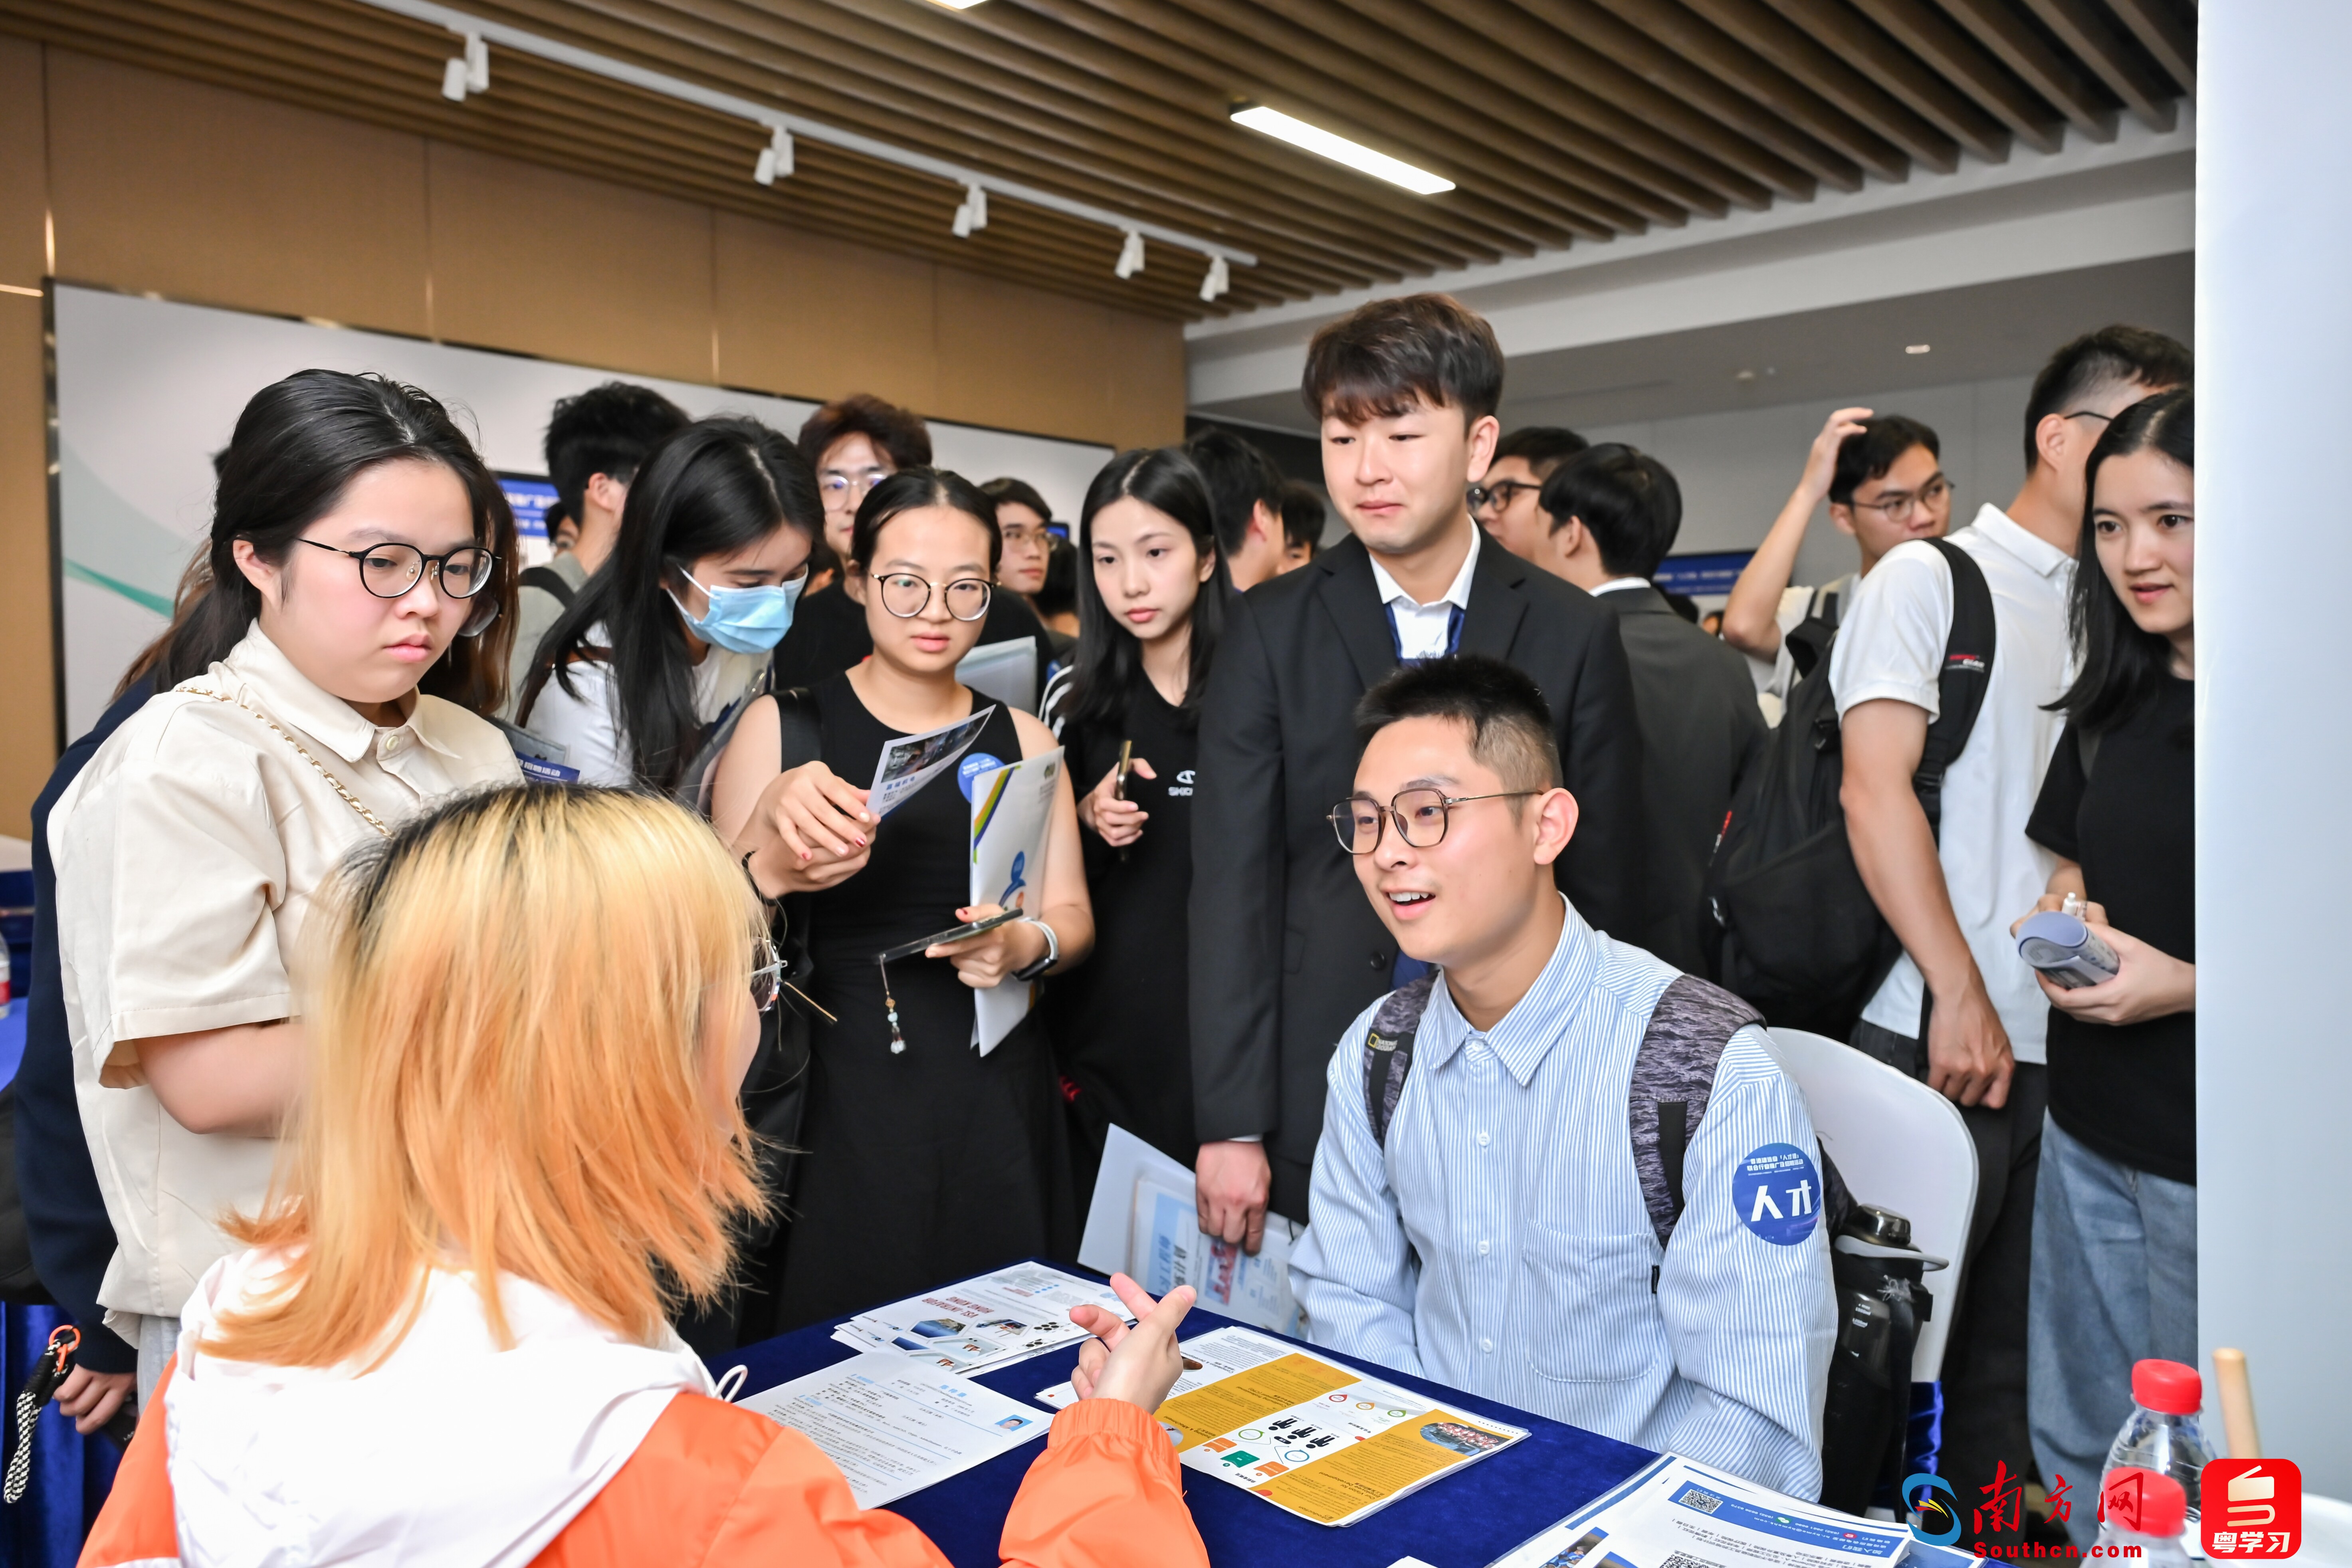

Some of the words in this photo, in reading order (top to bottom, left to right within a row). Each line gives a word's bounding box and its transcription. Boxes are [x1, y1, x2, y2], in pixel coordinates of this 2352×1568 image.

[1751, 1179, 1812, 1222] 人才
[1318, 1471, 1353, 1487] Development
[1349, 1487, 1364, 1497] Vision
[1842, 1544, 1883, 1555] 加入我们
